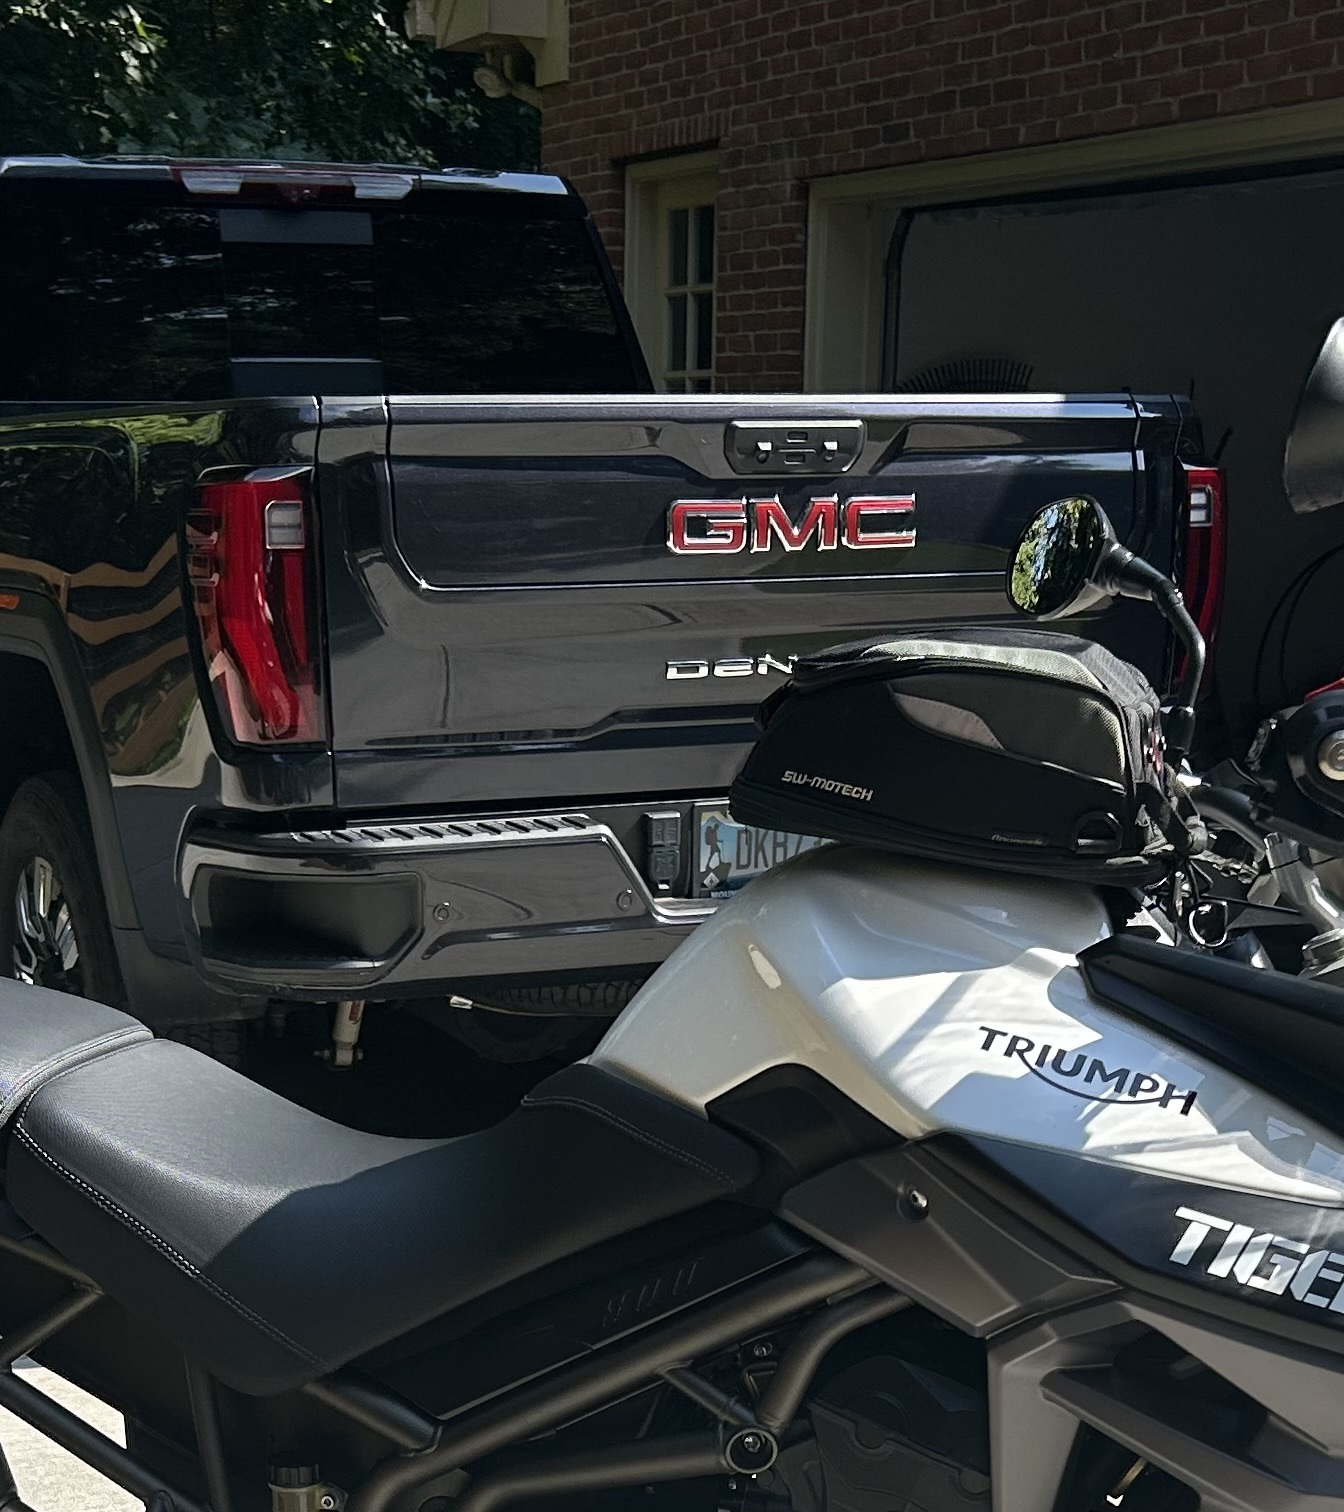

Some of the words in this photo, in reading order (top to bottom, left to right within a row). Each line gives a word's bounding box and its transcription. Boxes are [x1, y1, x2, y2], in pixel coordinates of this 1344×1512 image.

[666, 493, 916, 553] GMC
[666, 654, 798, 680] DEN
[781, 770, 874, 802] SW-MOTECH
[978, 1026, 1198, 1116] TRIUMPH
